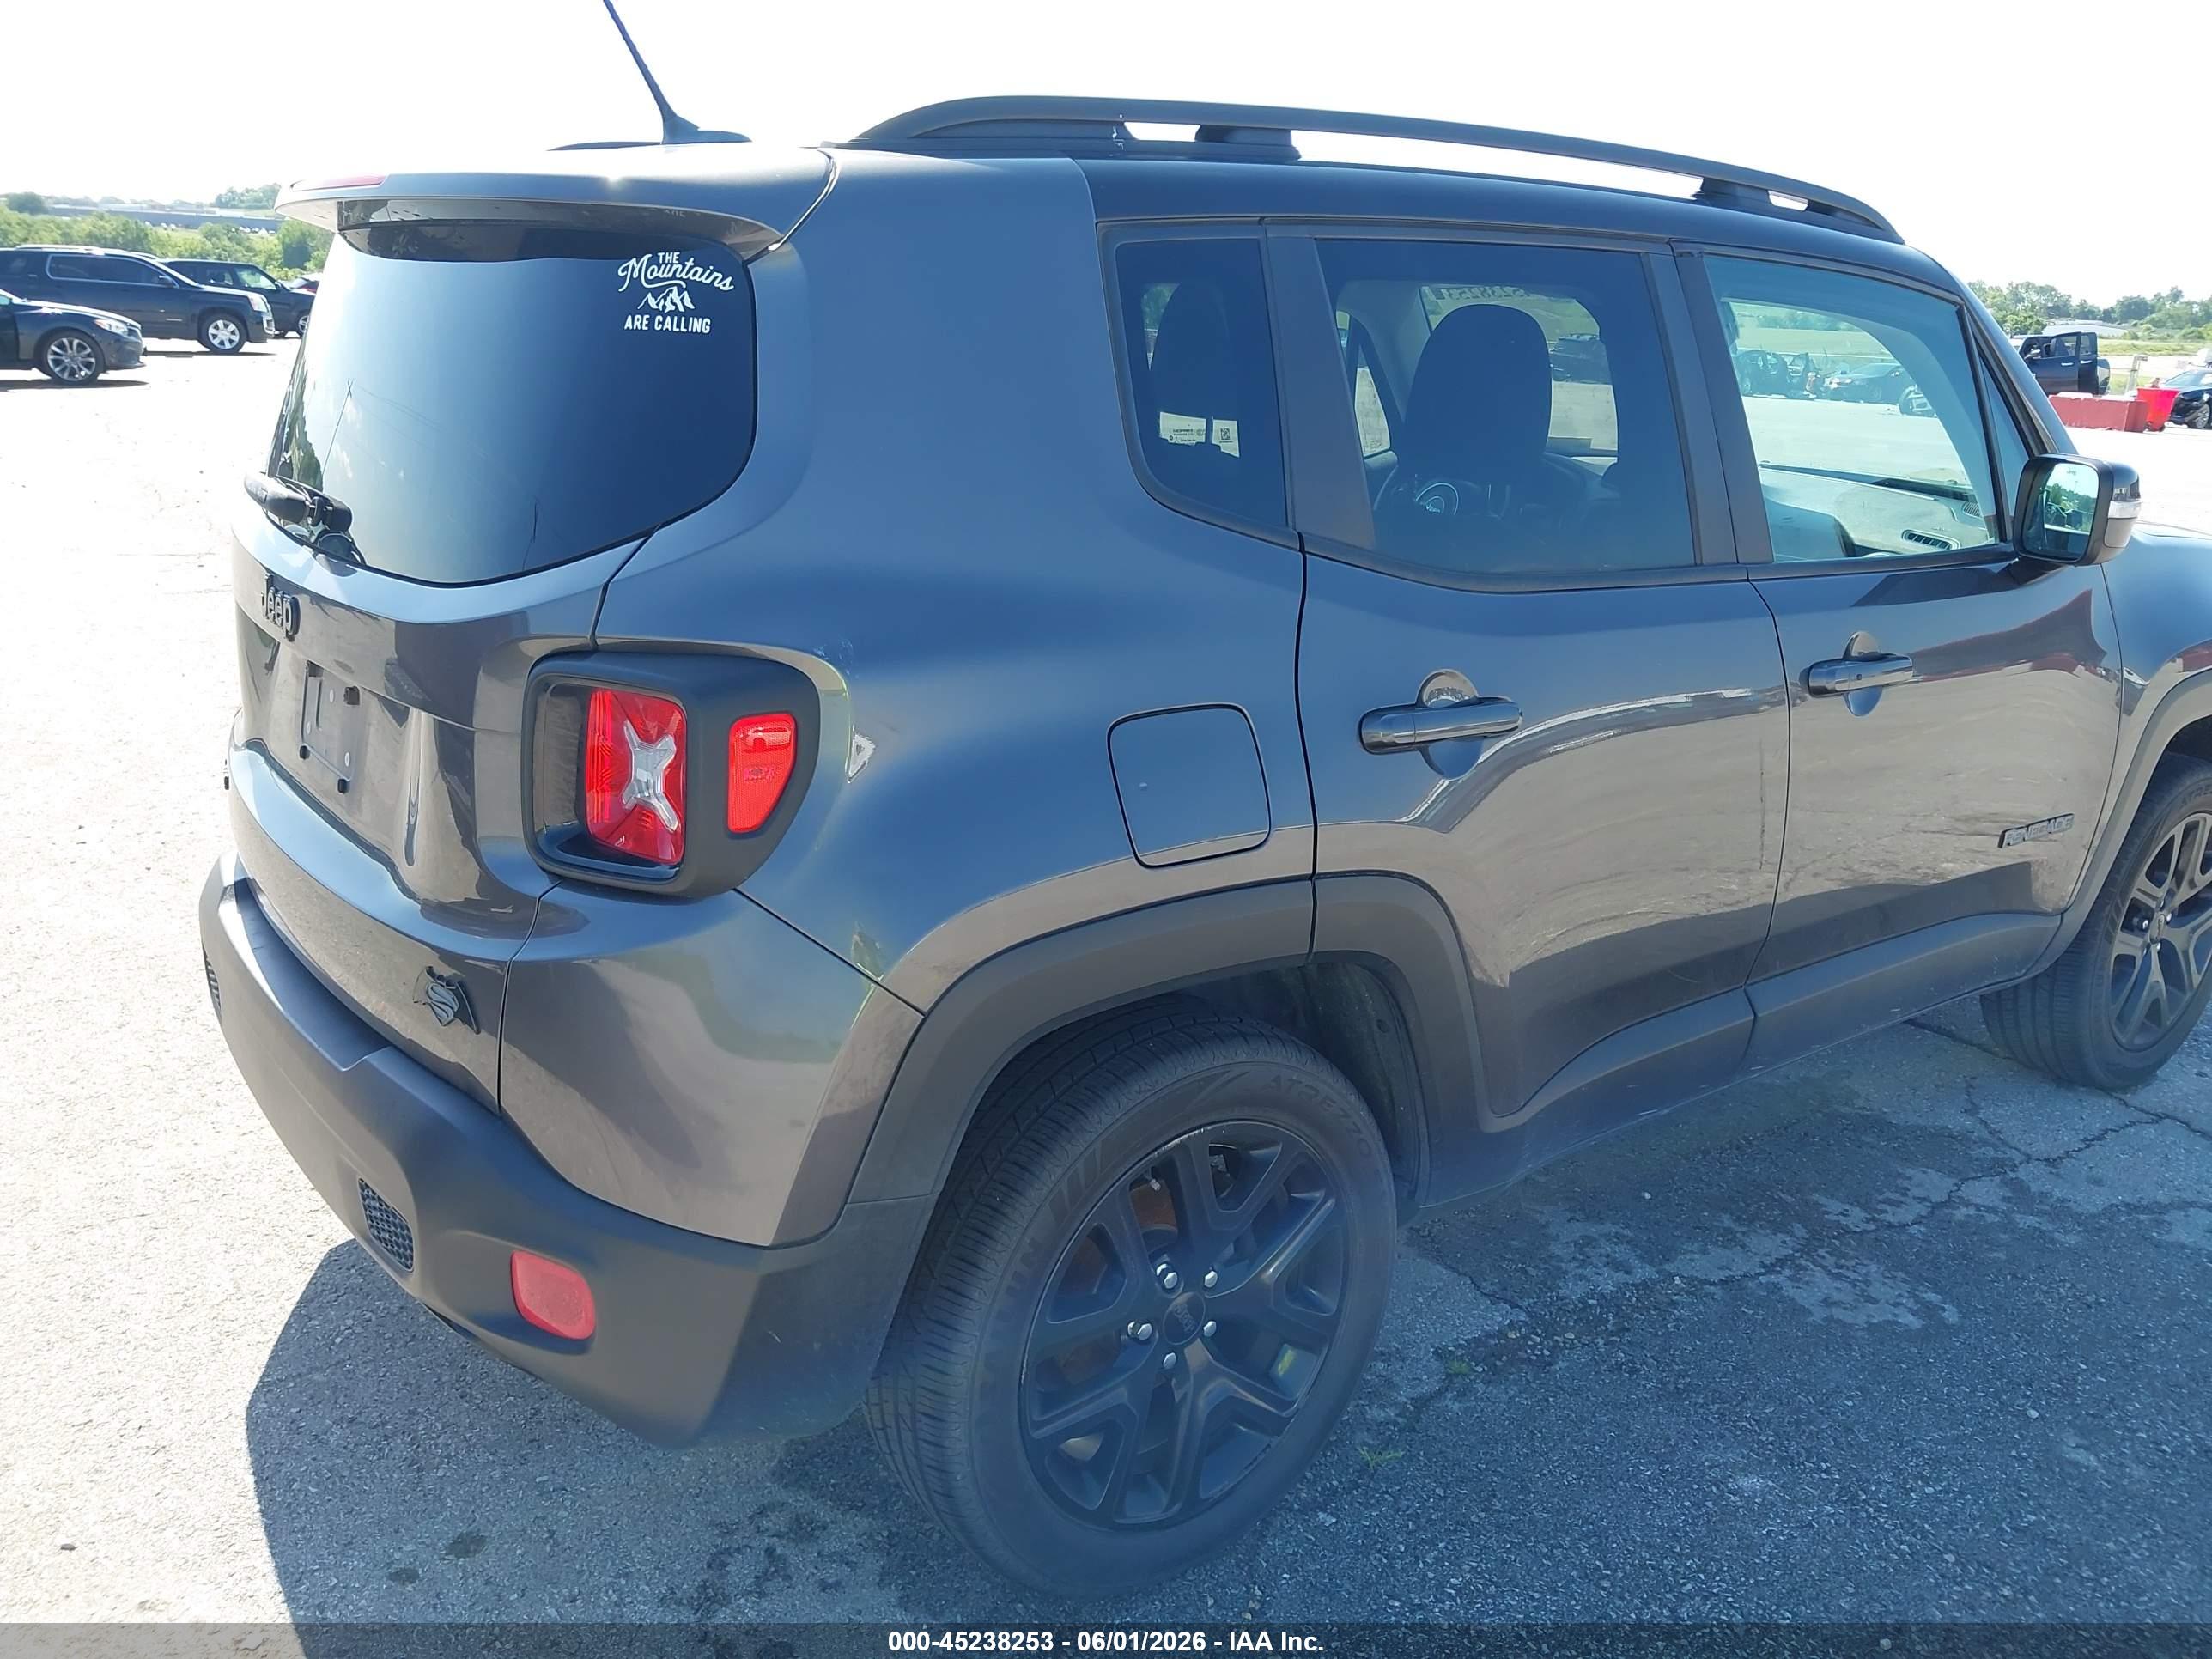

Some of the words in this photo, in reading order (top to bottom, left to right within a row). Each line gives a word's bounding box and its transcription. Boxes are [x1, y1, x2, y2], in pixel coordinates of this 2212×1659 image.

[617, 253, 735, 292] Mountains
[657, 252, 680, 264] THE
[623, 314, 650, 331] ARE
[654, 315, 711, 334] CALLING
[261, 573, 297, 641] Jeep
